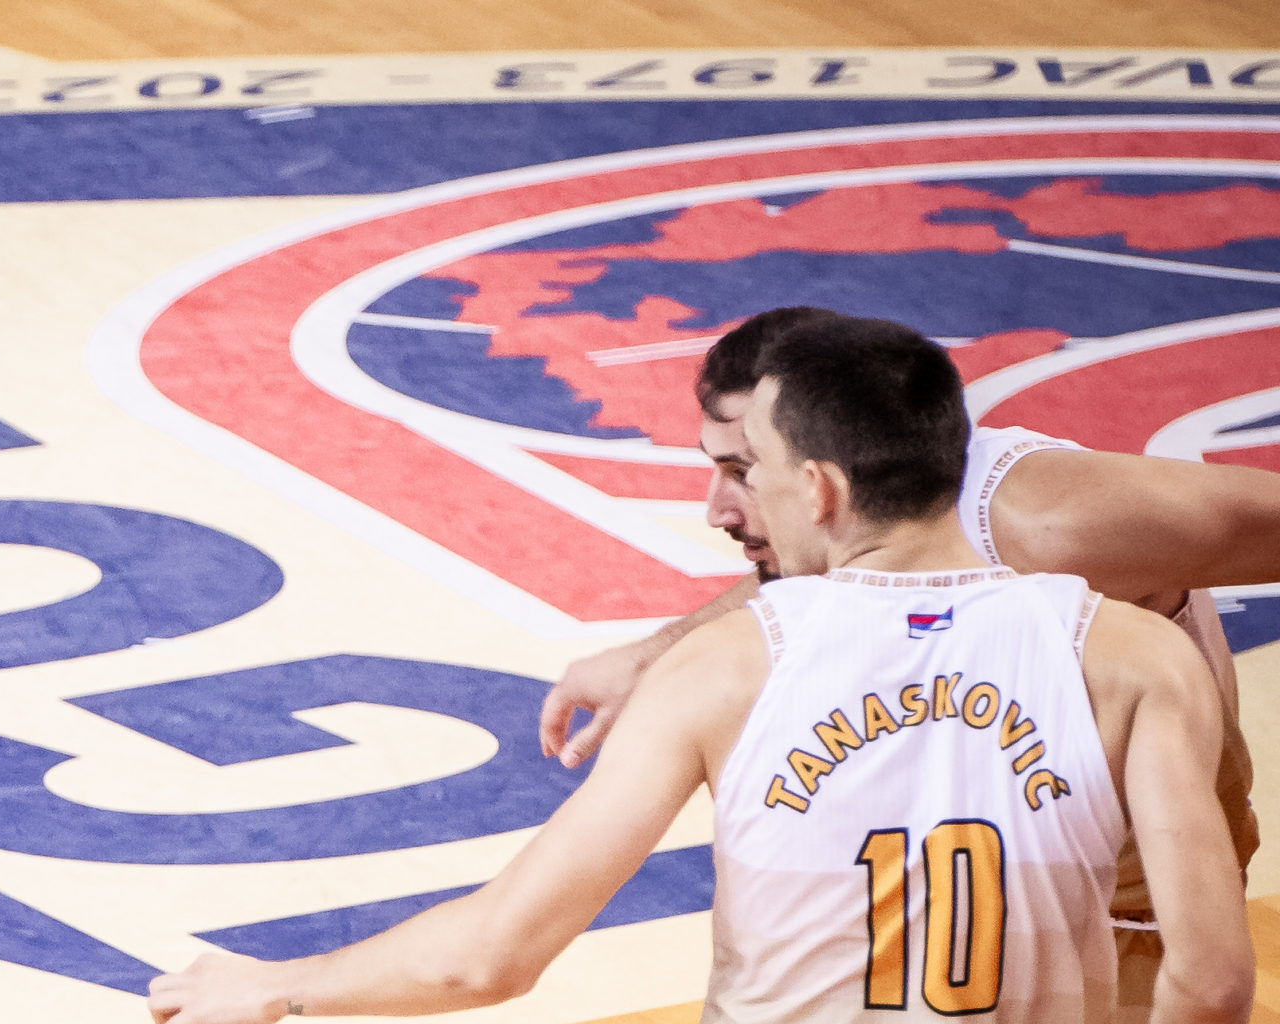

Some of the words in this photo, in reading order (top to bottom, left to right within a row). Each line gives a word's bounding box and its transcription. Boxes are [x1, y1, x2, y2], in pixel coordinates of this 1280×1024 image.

[491, 56, 870, 91] 1973
[765, 671, 1071, 813] TANASKOVIĆ
[854, 818, 1007, 1017] 10
